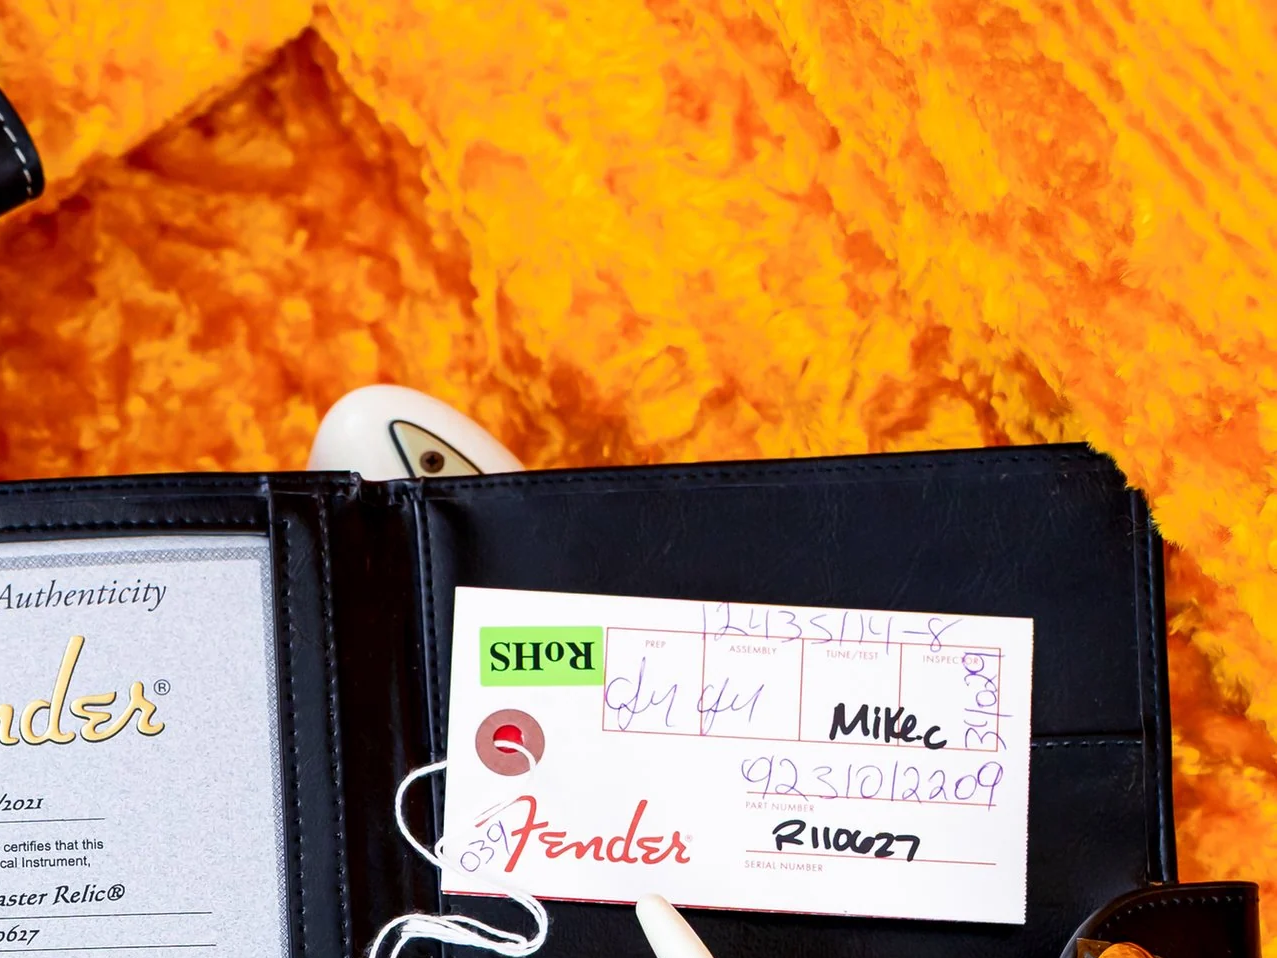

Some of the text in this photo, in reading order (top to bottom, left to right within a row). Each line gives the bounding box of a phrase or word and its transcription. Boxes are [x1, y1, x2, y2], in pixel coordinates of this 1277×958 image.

[645, 640, 666, 650] PREP
[729, 645, 777, 656] ASSEMBLY
[489, 641, 595, 672] RoHS
[826, 650, 879, 661] TUNE/TEST
[922, 654, 979, 666] INSPECTOR
[745, 801, 814, 813] PART NUMBER
[474, 794, 693, 873] Fender
[4, 841, 51, 852] certifies
[55, 840, 79, 850] that
[82, 838, 104, 850] this
[22, 856, 90, 868] Instrument,
[744, 860, 824, 872] SERIAL NUMBER
[52, 884, 125, 905] Relic®
